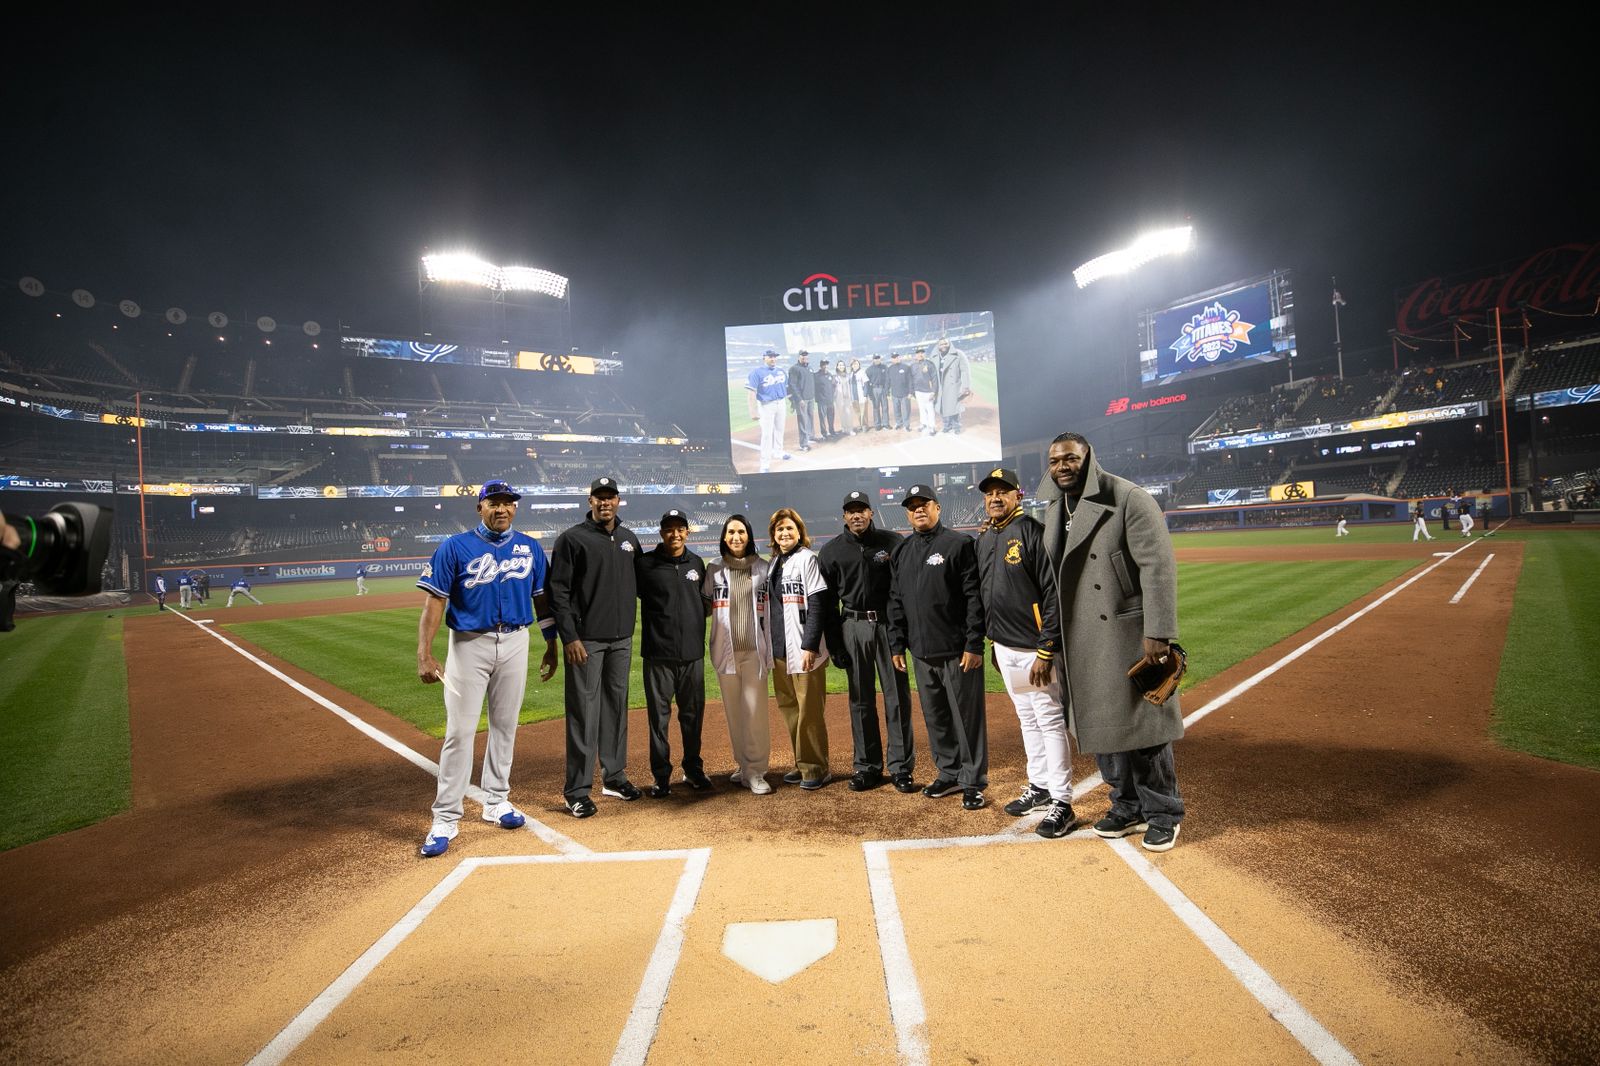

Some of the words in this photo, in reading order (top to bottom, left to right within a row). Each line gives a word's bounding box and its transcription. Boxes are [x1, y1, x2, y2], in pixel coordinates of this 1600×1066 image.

[25, 281, 39, 291] 41
[78, 294, 90, 304] 14
[783, 275, 838, 312] citi
[847, 280, 931, 308] FIELD
[123, 303, 137, 314] 37
[1191, 320, 1233, 343] TITANES
[1201, 340, 1221, 353] 2023
[1131, 401, 1149, 411] new
[1149, 393, 1187, 407] balance
[287, 425, 314, 434] VS
[1302, 424, 1332, 438] VS
[1268, 431, 1292, 441] LICEY
[36, 480, 68, 488] LICEY
[289, 486, 318, 497] VS
[361, 541, 375, 550] citi
[276, 565, 336, 578] Justworks
[464, 552, 534, 589] Licey
[782, 582, 805, 596] ANES
